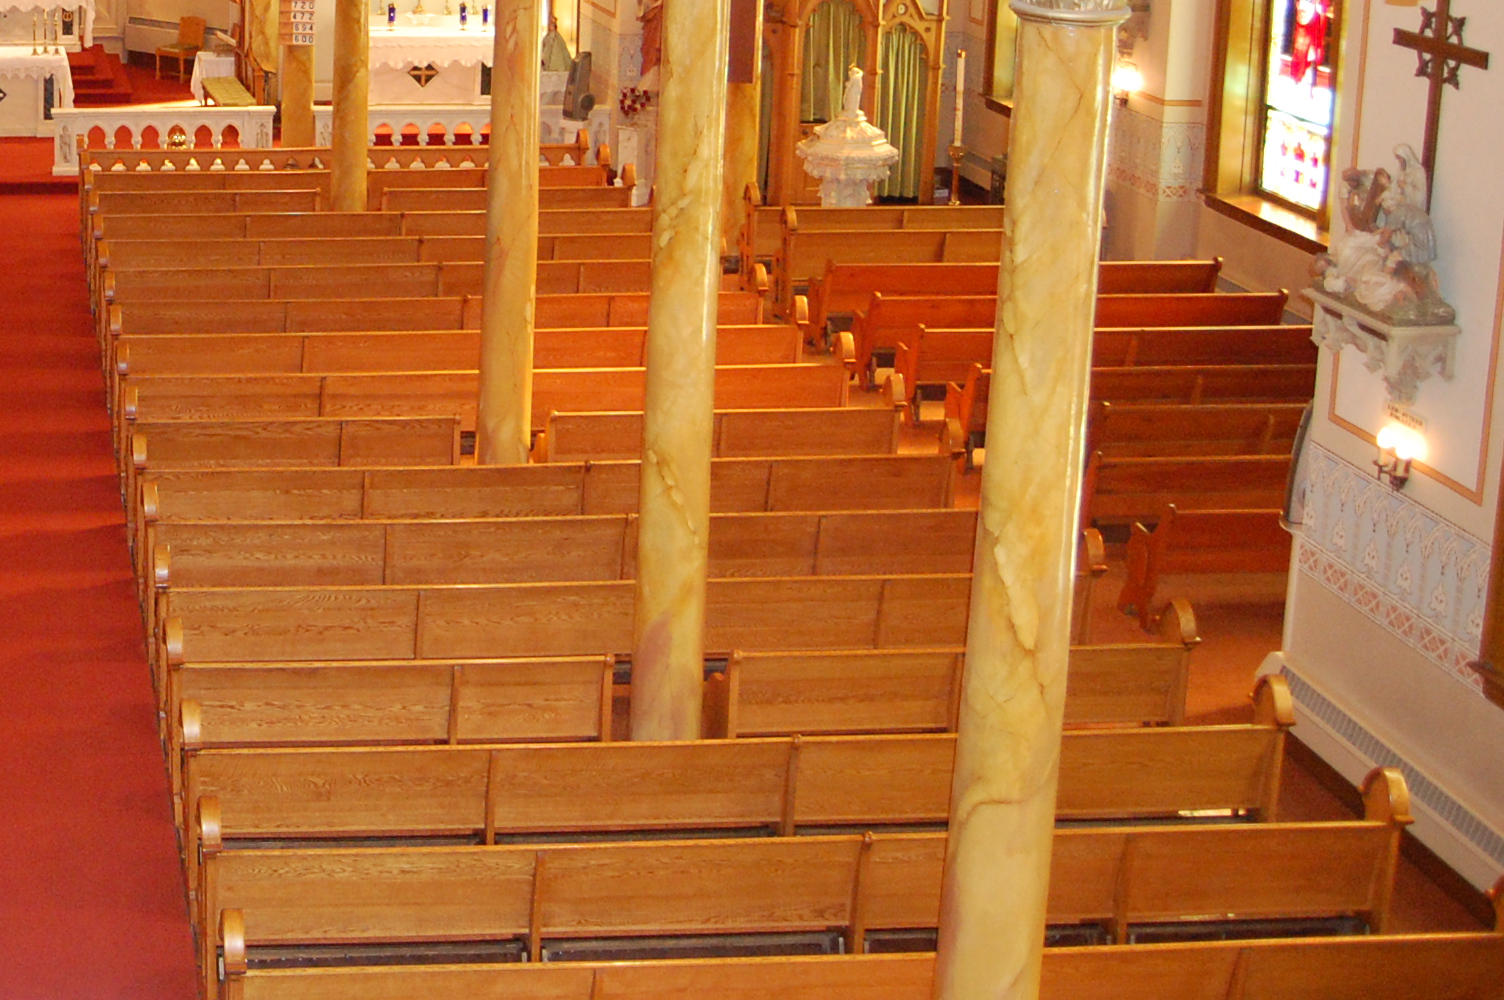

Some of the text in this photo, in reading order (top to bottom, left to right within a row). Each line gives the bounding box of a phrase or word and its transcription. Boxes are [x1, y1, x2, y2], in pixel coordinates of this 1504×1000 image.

[293, 1, 314, 10] 720
[292, 12, 314, 21] 472
[294, 24, 314, 32] 694
[294, 35, 314, 44] 600
